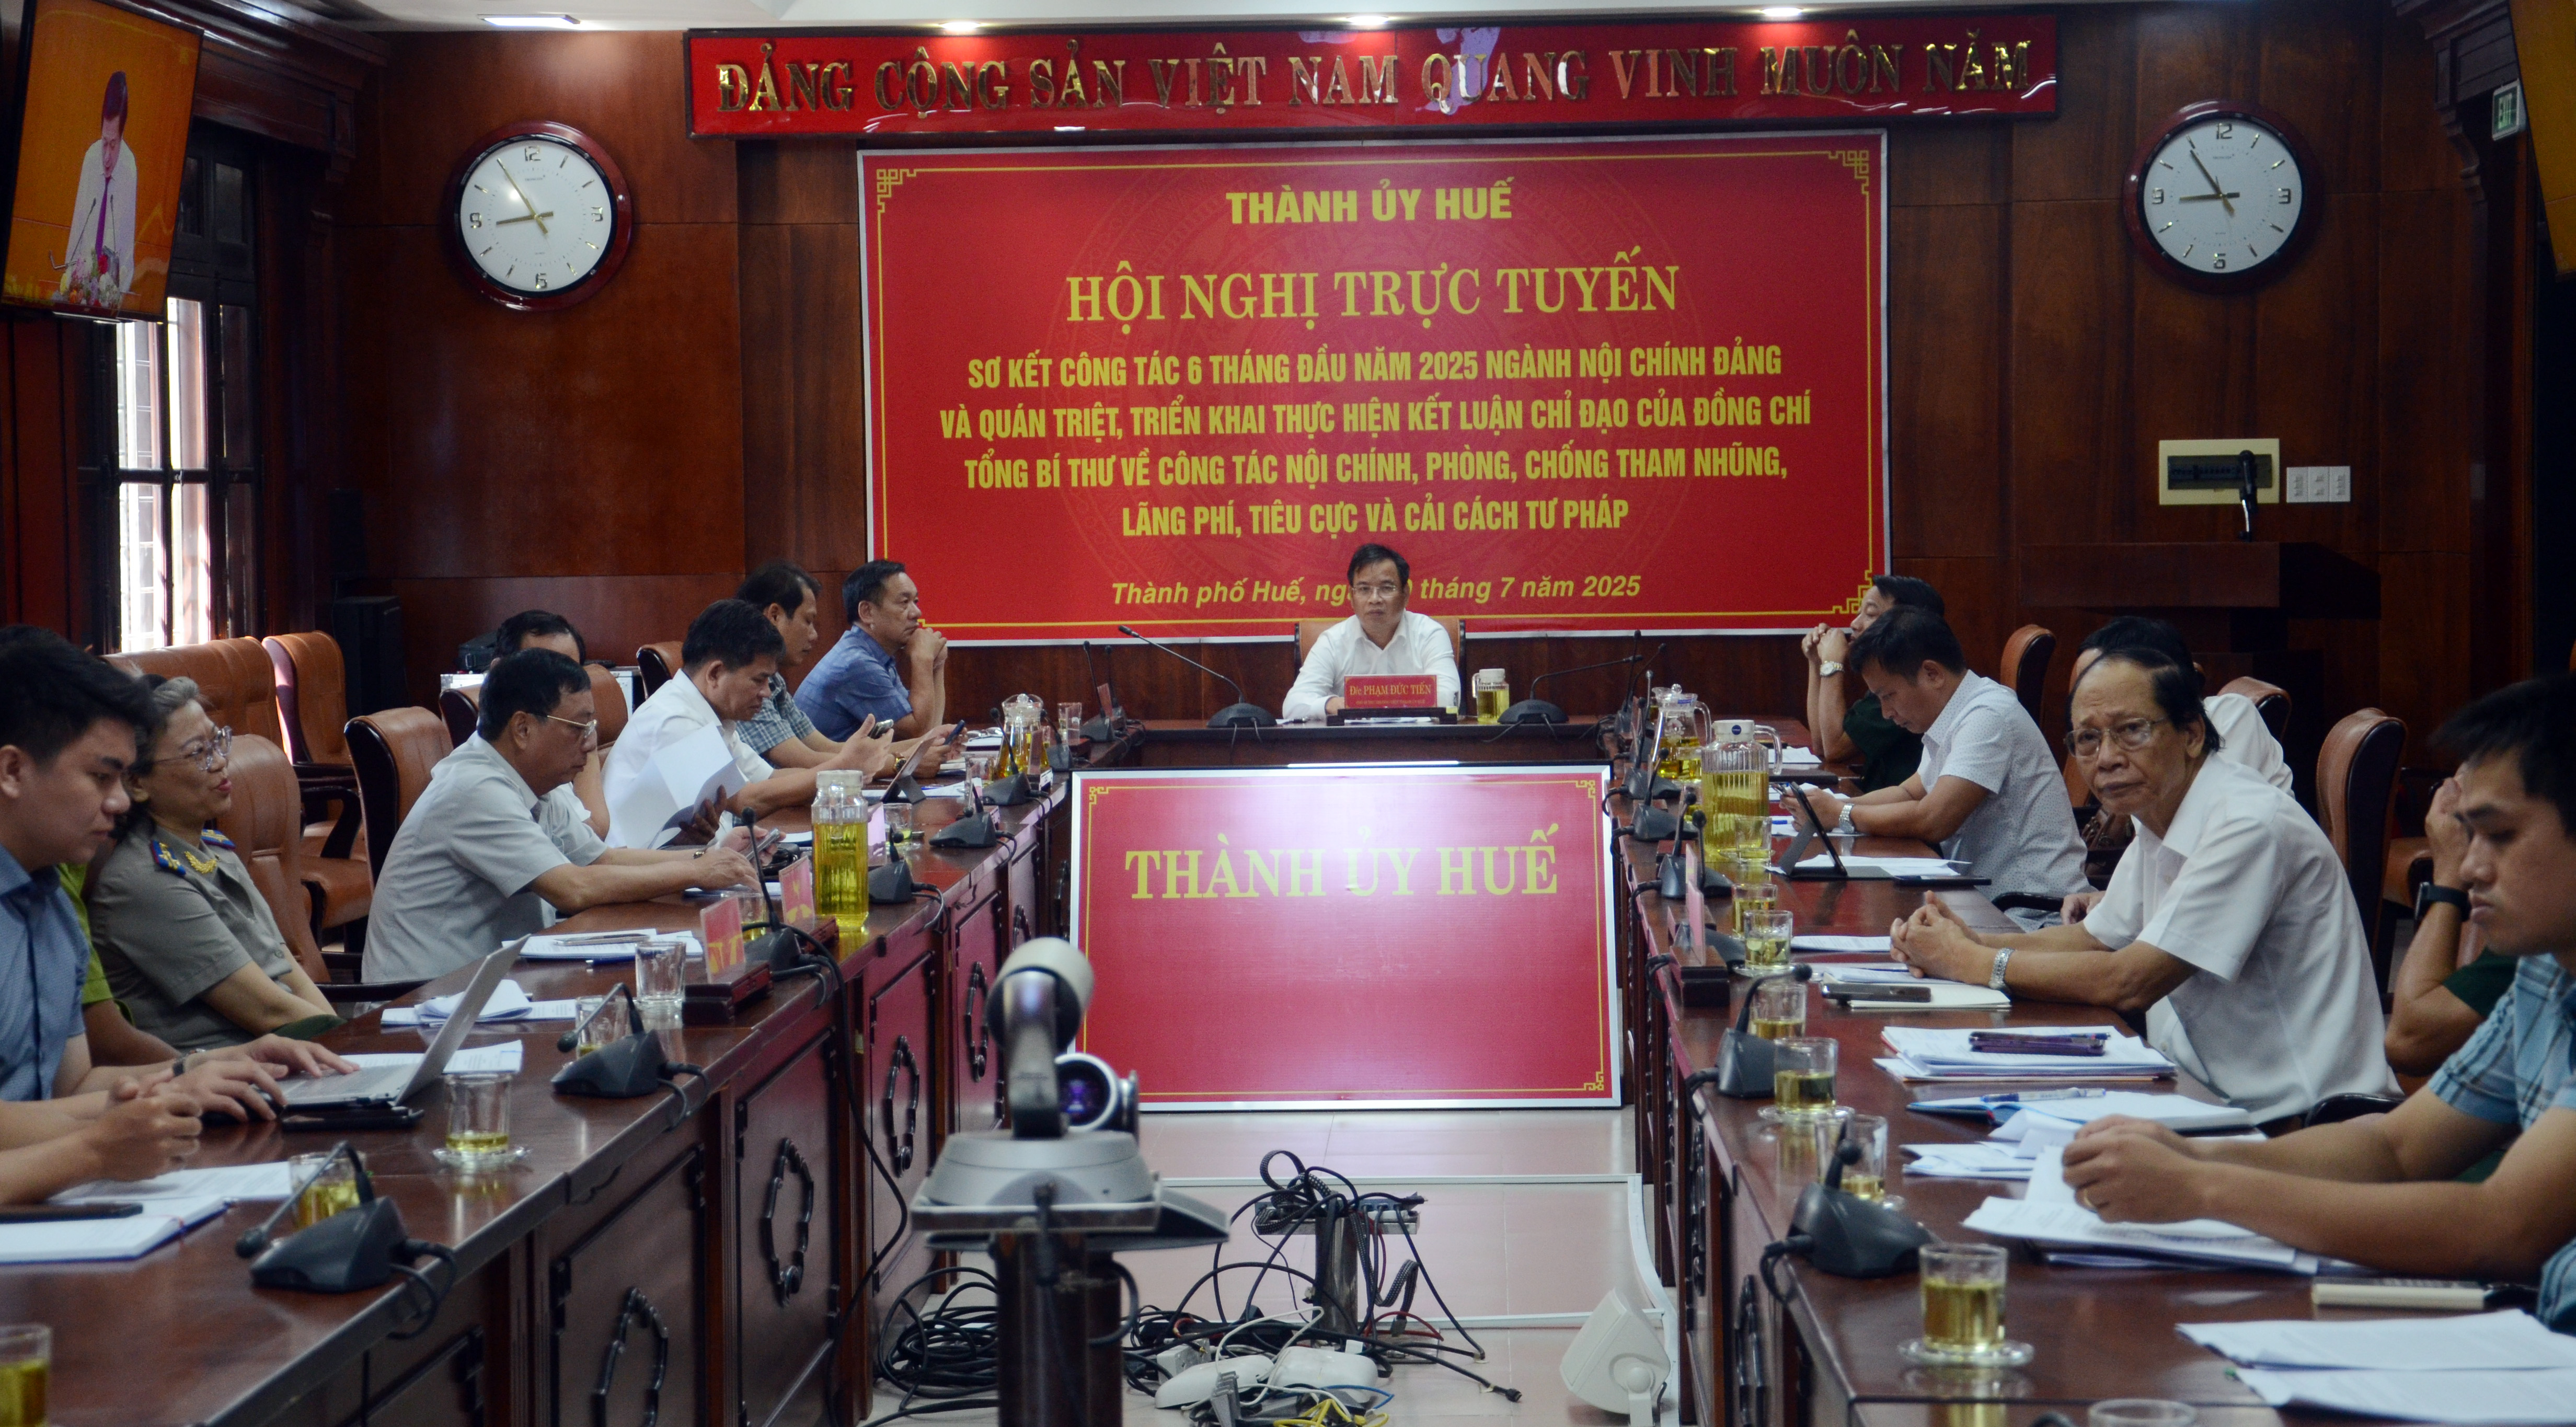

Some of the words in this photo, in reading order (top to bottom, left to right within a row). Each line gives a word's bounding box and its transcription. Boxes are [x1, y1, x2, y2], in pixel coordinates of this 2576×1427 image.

[716, 43, 852, 112] ĐẢNG
[876, 46, 1009, 120] CỘNG
[1029, 39, 1126, 109] SẢN
[1148, 42, 1267, 114] VIỆT
[1288, 54, 1399, 106] NAM
[1421, 50, 1588, 115] QUANG
[1608, 47, 1739, 99] VINH
[1760, 29, 1903, 96] MUÔN
[1922, 28, 2031, 92] NĂM
[524, 146, 540, 162] 12
[2216, 123, 2233, 139] 12
[1226, 185, 1358, 224] THÀNH
[1372, 178, 1421, 221] ỦY
[1435, 177, 1515, 220] HUẾ
[1066, 260, 1165, 335] HỘI
[1180, 272, 1319, 330] NGHỊ
[1334, 262, 1480, 328] TRỰC
[1497, 245, 1679, 313] TUYẾN
[968, 356, 1001, 388] SƠ
[1008, 349, 1053, 387] KẾT
[1060, 351, 1127, 387] CÔNG
[1133, 350, 1180, 385] TÁC
[1187, 355, 1202, 385] 6
[1209, 348, 1290, 384] THÁNG
[1297, 344, 1347, 383] ĐẦU
[1354, 348, 1411, 381] NĂM
[1419, 351, 1479, 380] 2025
[1486, 343, 1571, 379] NGÀNH
[1579, 341, 1622, 384] NỘI
[1630, 341, 1706, 377] CHÍNH
[1713, 336, 1781, 375] ĐẢNG
[940, 404, 972, 439] VÀ
[980, 403, 1046, 441] QUÁN
[1053, 401, 1123, 443] TRIỆT,
[1130, 395, 1201, 436] TRIỂN
[1209, 405, 1266, 434] KHAI
[1272, 401, 1335, 442] THỰC
[1343, 396, 1400, 439] HIỆN
[1408, 392, 1452, 431] KẾT
[1460, 395, 1523, 436] LUẬN
[1531, 390, 1572, 429] CHỈ
[1579, 398, 1629, 434] ĐẠO
[1637, 388, 1687, 428] CỦA
[1693, 387, 1762, 426] ĐỒNG
[1770, 389, 1811, 425] CHÍ
[964, 448, 1028, 489] TỔNG
[1037, 453, 1060, 488] BÍ
[1067, 455, 1116, 487] THƯ
[1121, 447, 1151, 486] VỀ
[1158, 450, 1225, 486] CÔNG
[1232, 449, 1278, 485] TÁC
[1286, 448, 1328, 489] NỘI
[1336, 447, 1419, 484] CHÍNH,
[1427, 444, 1517, 482] PHÒNG,
[1525, 440, 1609, 480] CHỐNG
[1616, 448, 1686, 478] THAM
[1694, 442, 1787, 478] NHŨNG,
[1123, 501, 1186, 536] LÃNG
[1194, 500, 1242, 537] PHÍ,
[1248, 499, 1302, 534] TIÊU
[1309, 501, 1358, 539] CỰC
[1366, 497, 1397, 532] VÀ
[1405, 493, 1445, 532] CẢI
[1453, 496, 1519, 531] CÁCH
[1525, 497, 1558, 530] TƯ
[1563, 493, 1629, 529] PHÁP
[1113, 581, 1189, 604] Thành
[1196, 578, 1247, 608] phố
[1252, 577, 1306, 603] Huế,
[1315, 584, 1351, 607] ng
[1420, 578, 1491, 604] tháng
[1501, 577, 1515, 597] 7
[1522, 575, 1574, 597] năm
[1582, 575, 1641, 597] 2025
[1364, 685, 1388, 696] PHẠM
[1390, 683, 1409, 695] ĐỨC
[1410, 681, 1431, 695] TIẾN
[1125, 833, 1326, 899] THÀNH
[1343, 826, 1421, 897] ỦY
[1436, 822, 1559, 895] HUẾ
